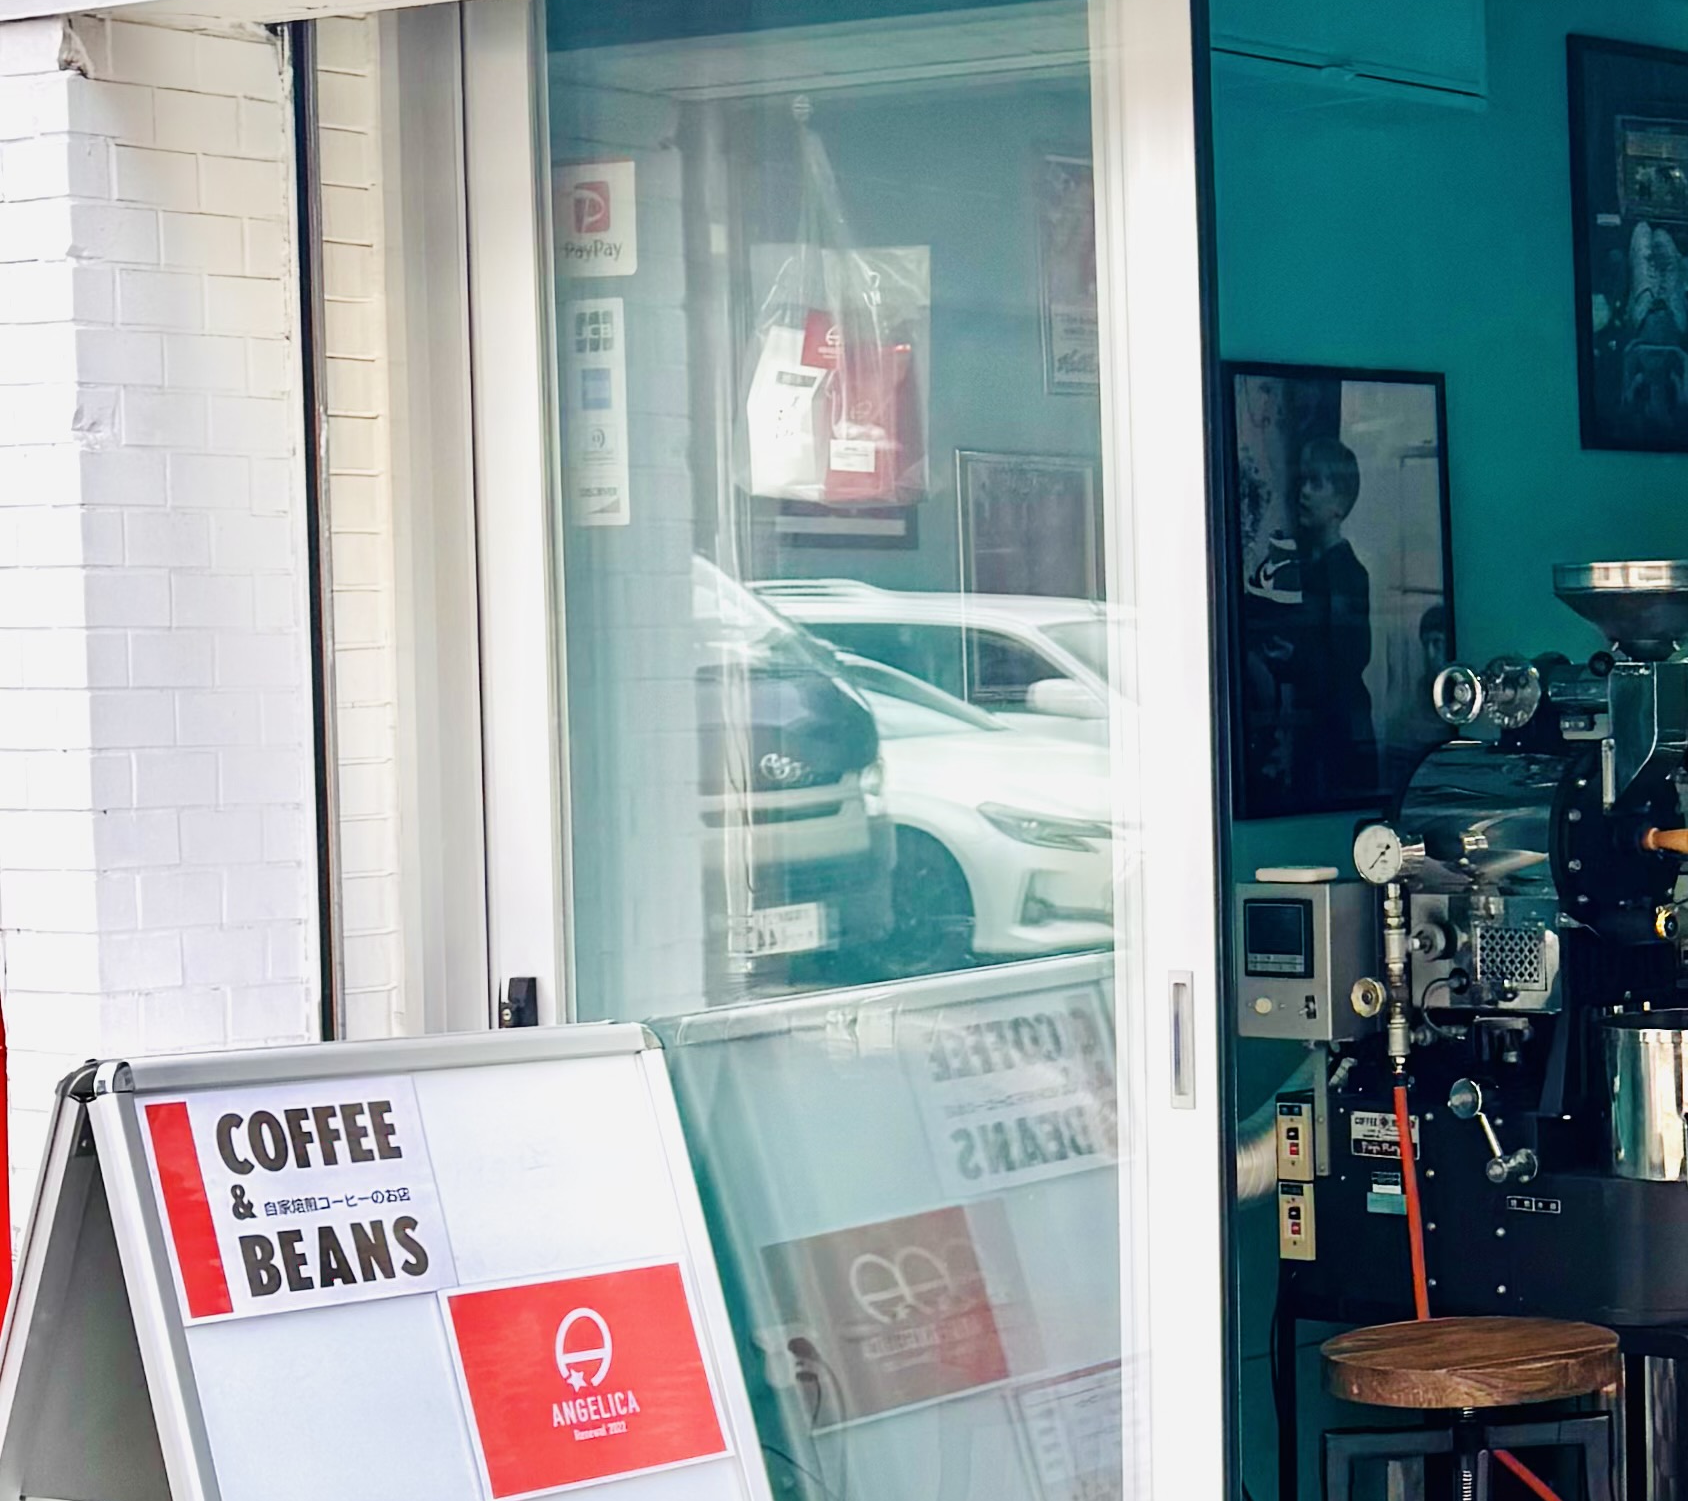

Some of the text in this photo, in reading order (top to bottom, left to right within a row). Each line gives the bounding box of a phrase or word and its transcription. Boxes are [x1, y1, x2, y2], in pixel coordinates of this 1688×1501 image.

[565, 239, 622, 262] PayPay
[215, 1100, 403, 1176] COFFEE
[230, 1184, 411, 1221] & 自家焙煎コーヒーのお店
[238, 1216, 429, 1297] BEANS
[552, 1390, 640, 1427] ANGELICA
